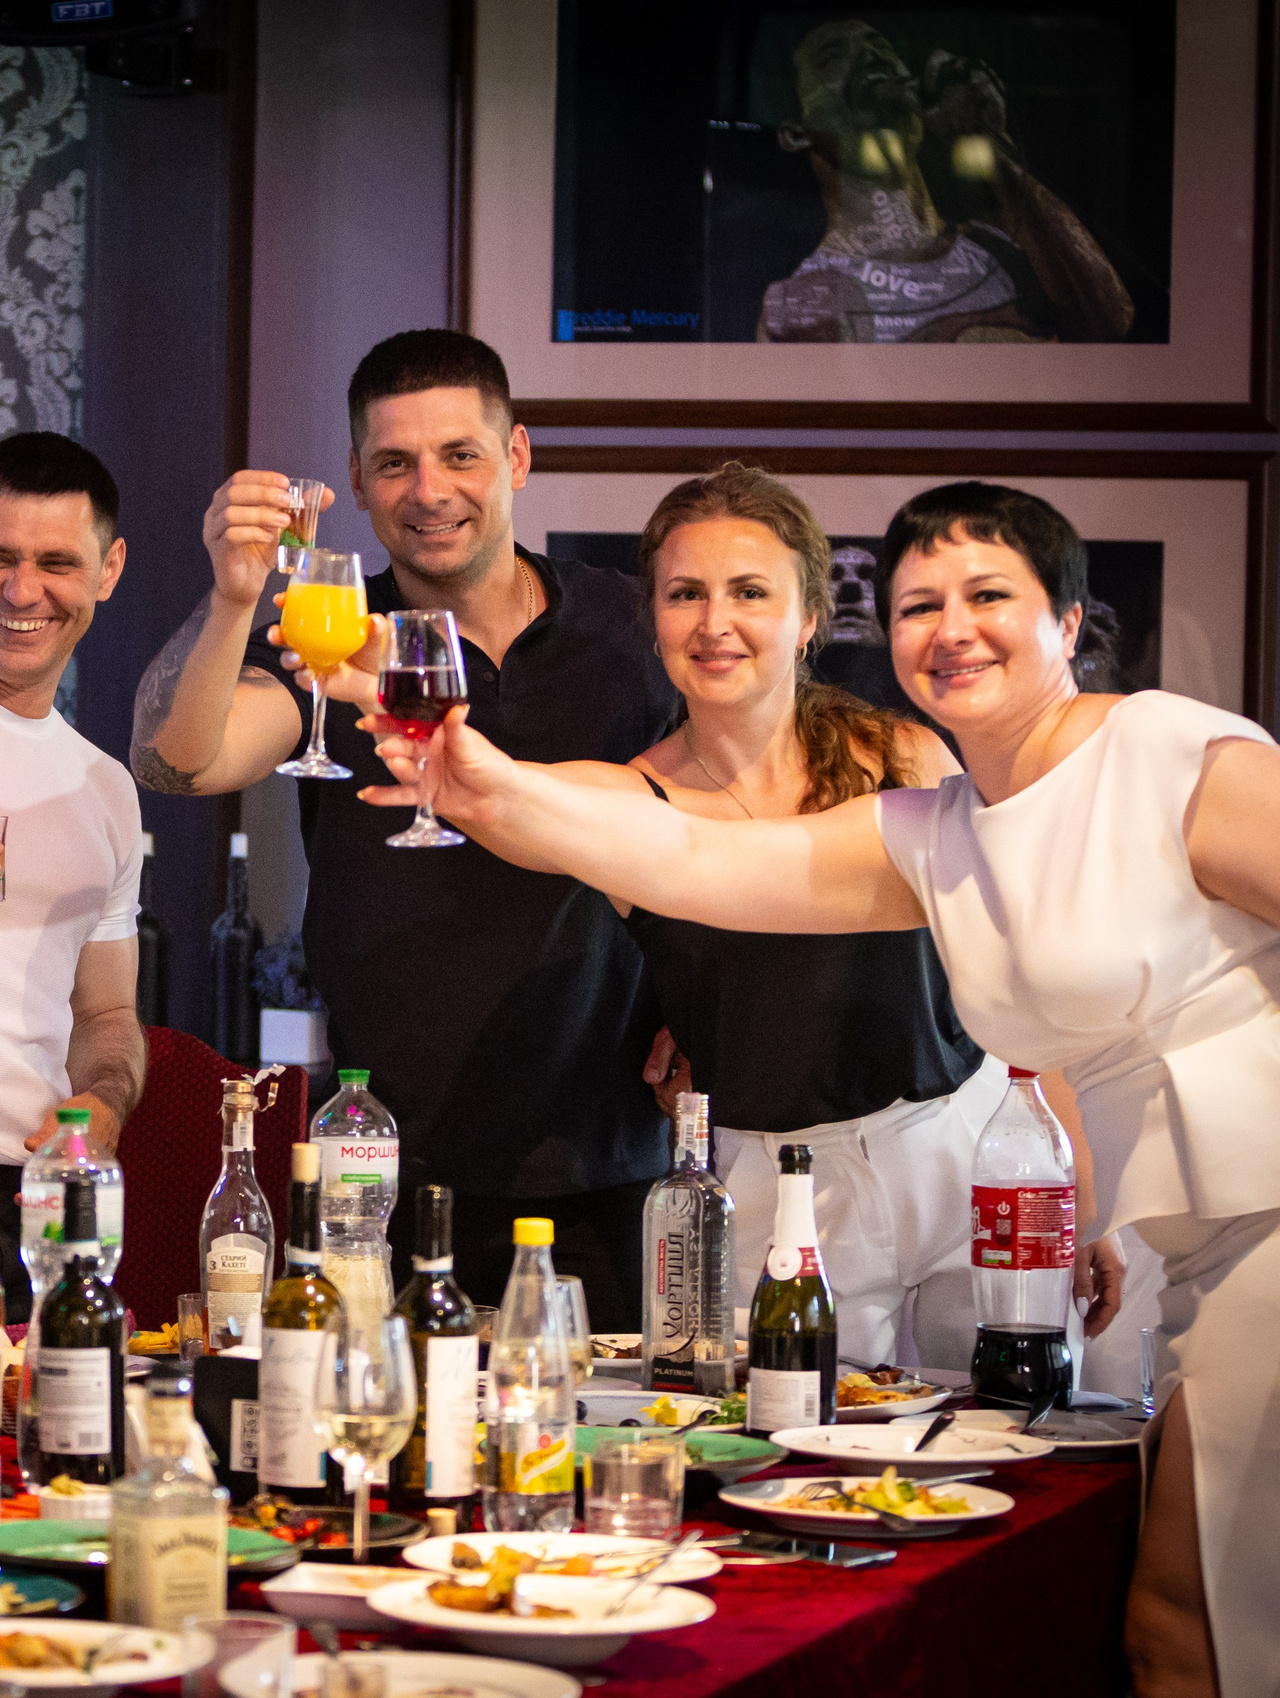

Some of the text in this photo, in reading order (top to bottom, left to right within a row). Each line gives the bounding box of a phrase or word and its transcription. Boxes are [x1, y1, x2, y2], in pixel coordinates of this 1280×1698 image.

[58, 1, 106, 18] FBT
[861, 261, 920, 298] love
[565, 308, 700, 331] reddie Mercury
[873, 314, 917, 327] know
[654, 1367, 694, 1377] PLATINUM
